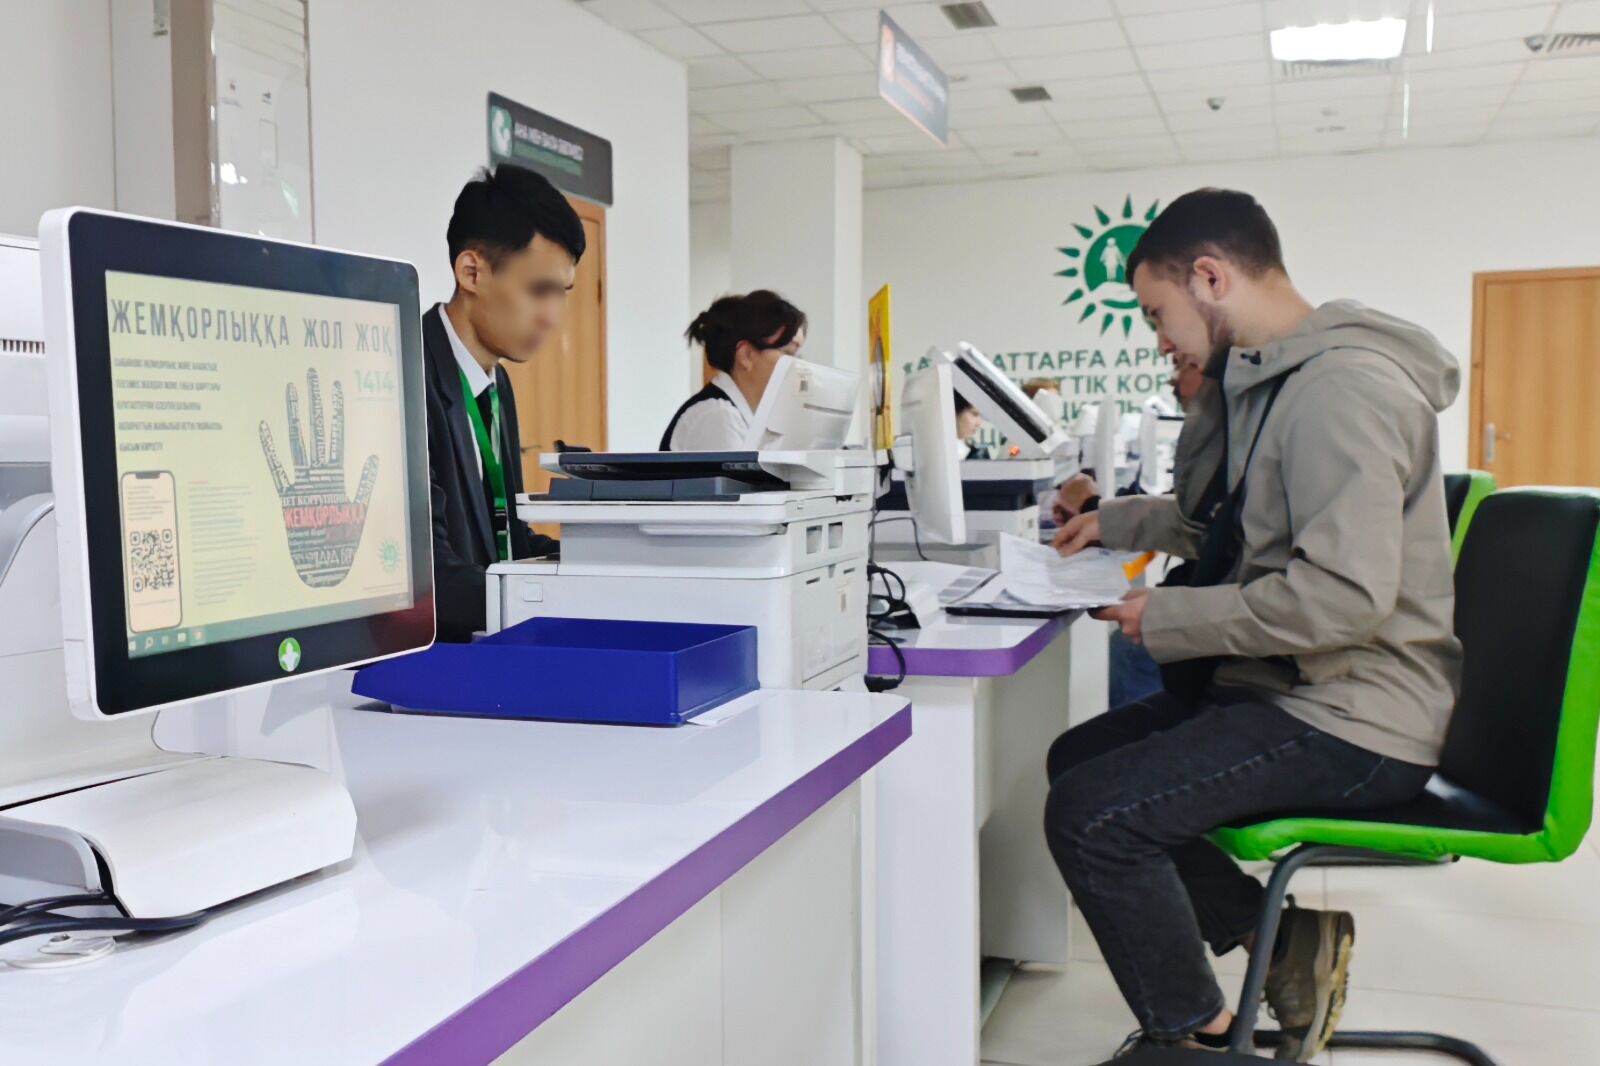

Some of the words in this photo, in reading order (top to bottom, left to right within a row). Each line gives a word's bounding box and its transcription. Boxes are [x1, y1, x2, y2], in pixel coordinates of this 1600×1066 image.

[111, 298, 290, 349] ЖЕМҚОРЛЫҚҚА
[303, 317, 343, 349] ЖОЛ
[355, 321, 393, 357] ЖОҚ
[1115, 347, 1168, 367] АРН
[355, 369, 395, 394] 1414
[1117, 373, 1168, 394] КОР
